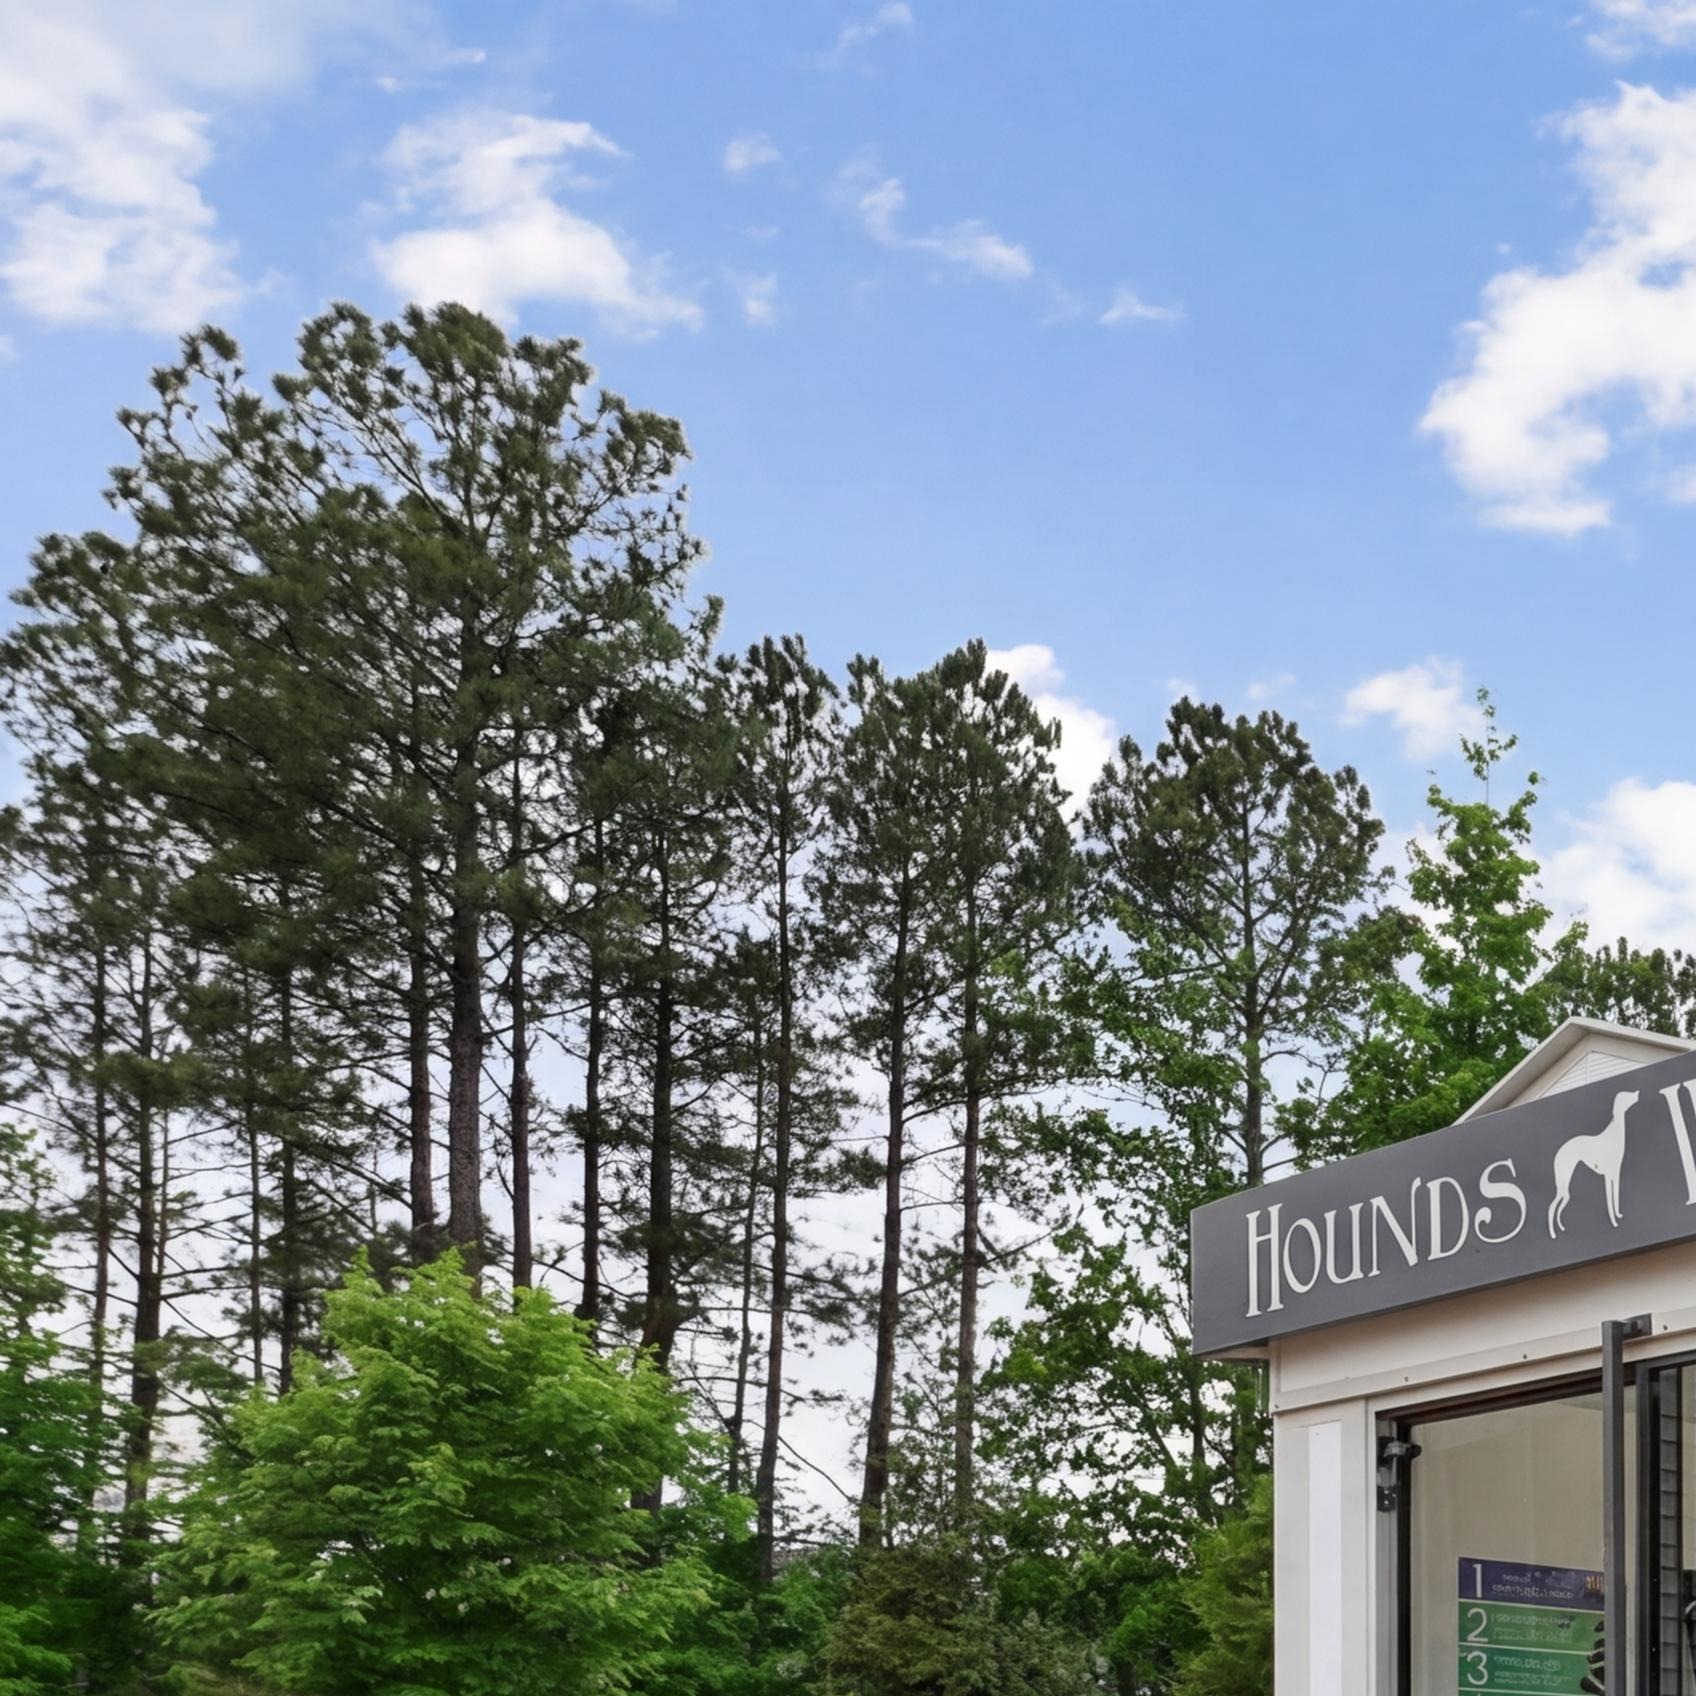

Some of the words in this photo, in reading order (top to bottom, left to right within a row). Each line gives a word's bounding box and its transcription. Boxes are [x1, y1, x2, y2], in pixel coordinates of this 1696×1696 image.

[1244, 1158, 1528, 1318] HOUNDS
[1473, 1564, 1482, 1598] 1
[1467, 1607, 1488, 1642] 2
[1467, 1650, 1488, 1685] 3
